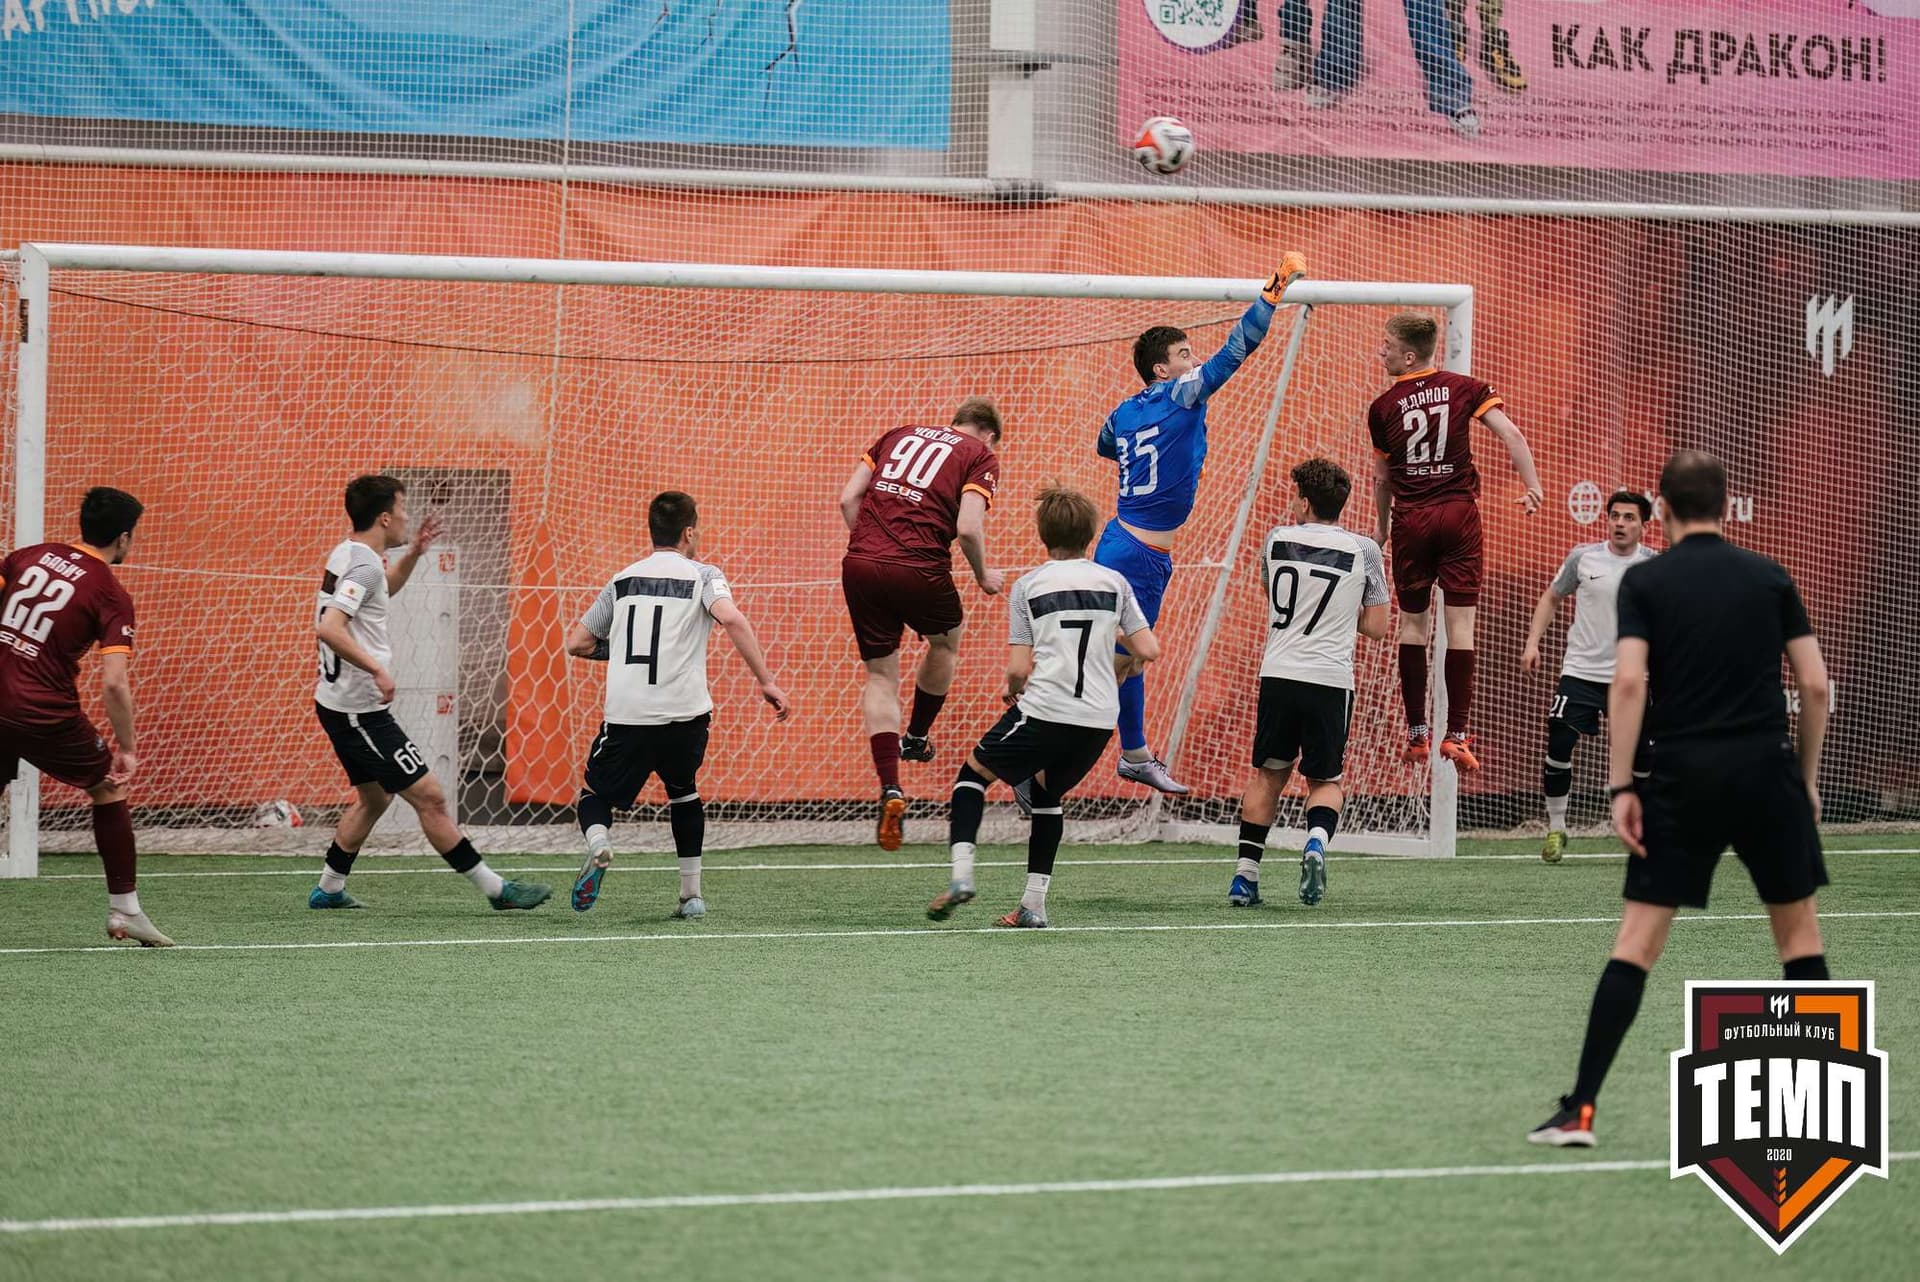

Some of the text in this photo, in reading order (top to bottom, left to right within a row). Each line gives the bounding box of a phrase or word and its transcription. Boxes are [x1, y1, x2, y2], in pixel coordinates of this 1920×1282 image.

[1552, 23, 1887, 86] КАК ДРАКОН!
[1397, 386, 1450, 414] ЖДАНОВ
[881, 435, 953, 490] 90
[1402, 403, 1450, 464] 27
[874, 480, 924, 503] SEUS
[1405, 463, 1454, 476] SEUS
[38, 551, 88, 582] БАБИЧ
[0, 564, 76, 644] 22
[1271, 565, 1341, 636] 97
[625, 604, 664, 685] 4
[1059, 619, 1094, 699] 7
[1549, 694, 1569, 719] 21
